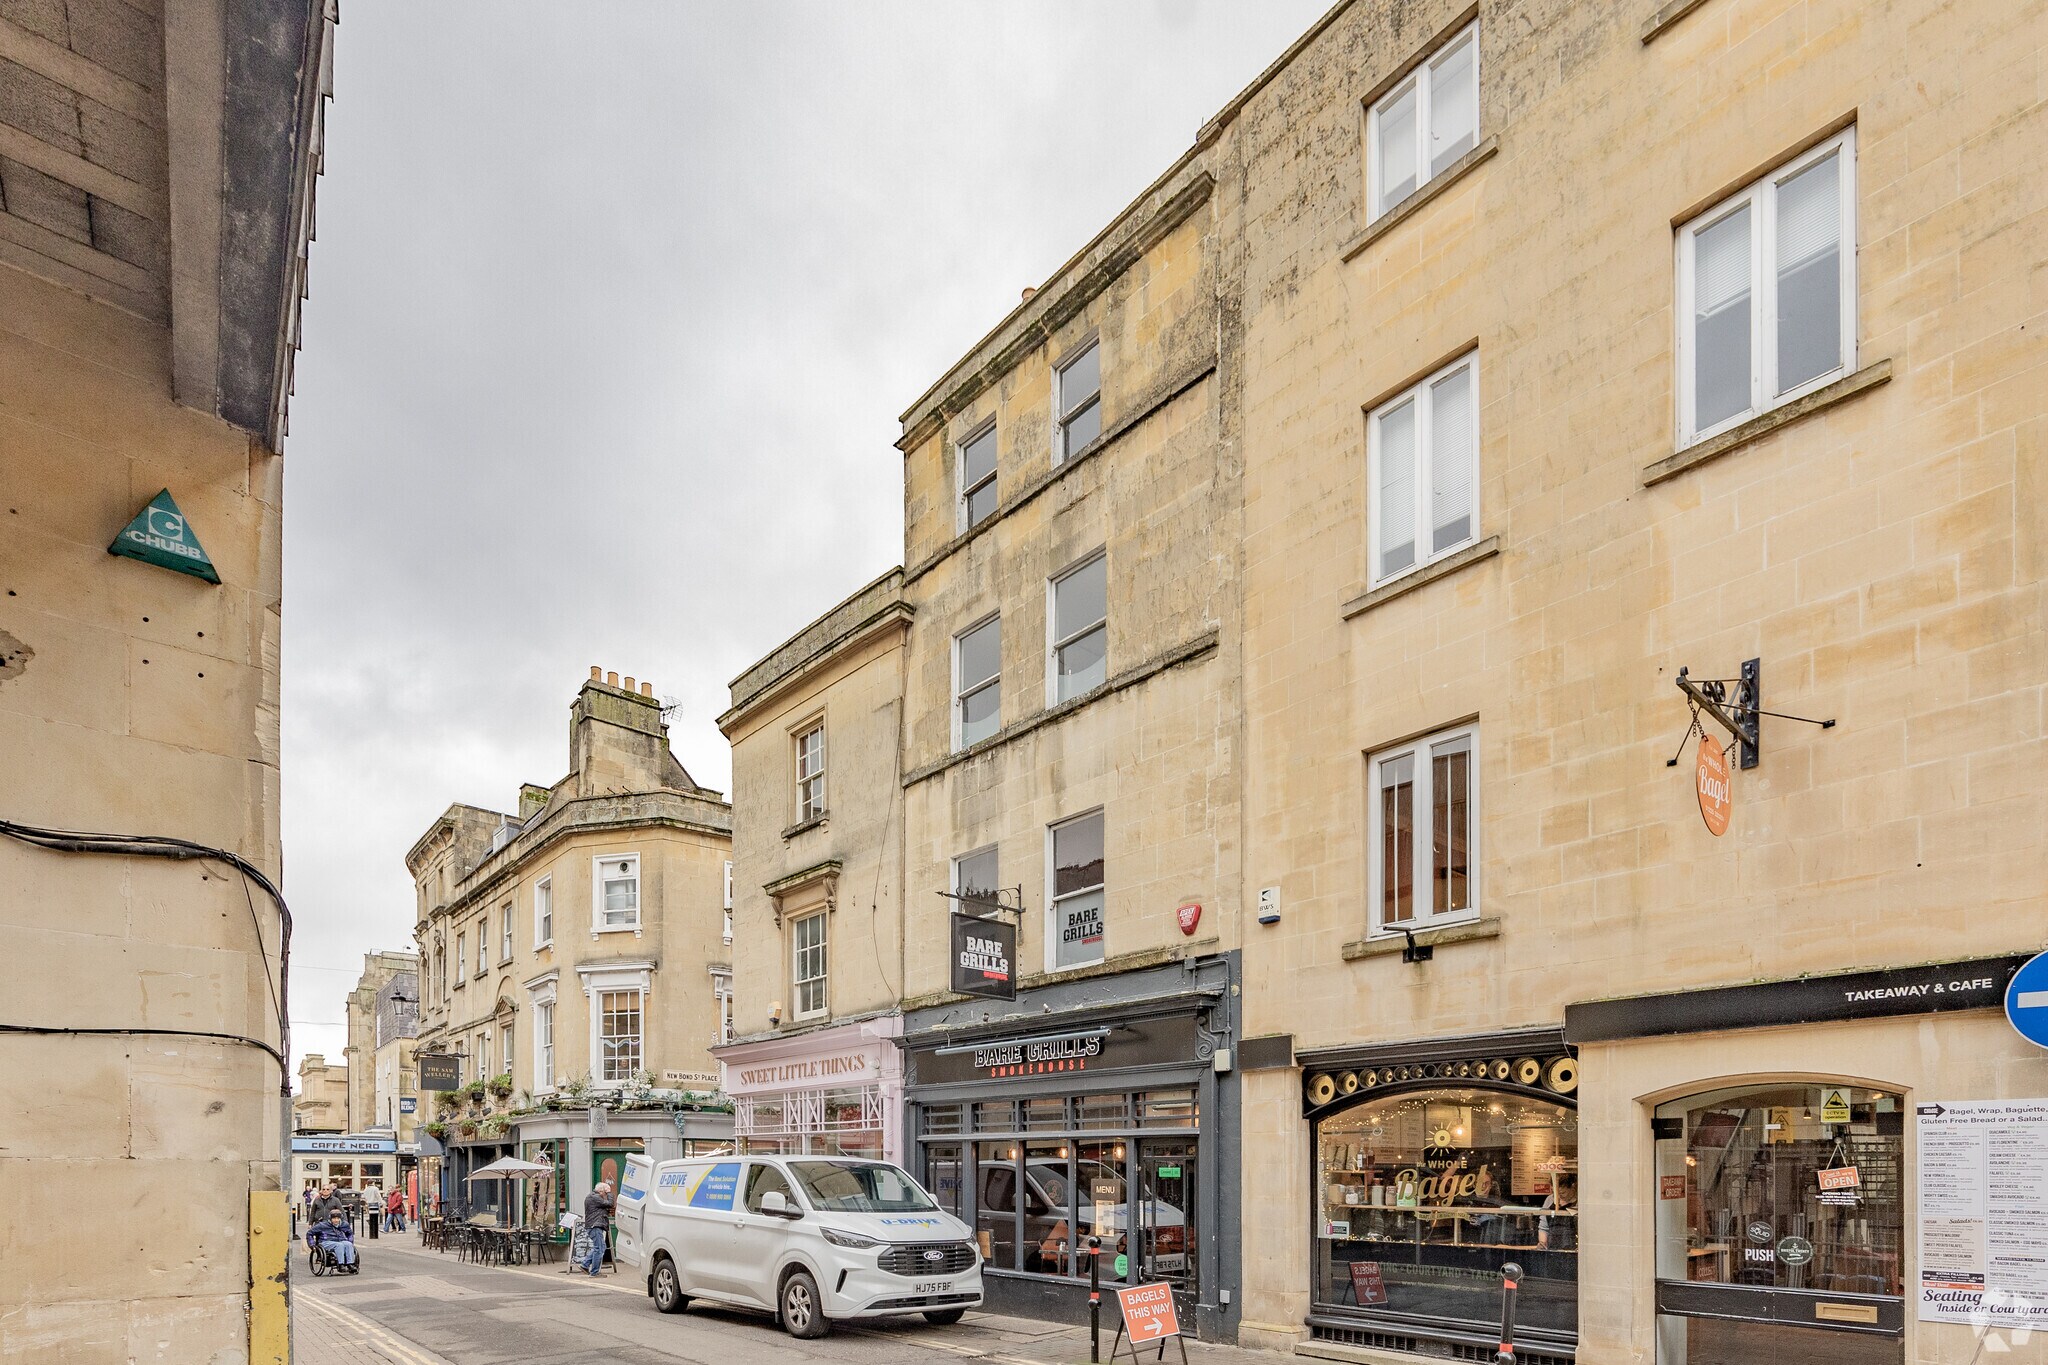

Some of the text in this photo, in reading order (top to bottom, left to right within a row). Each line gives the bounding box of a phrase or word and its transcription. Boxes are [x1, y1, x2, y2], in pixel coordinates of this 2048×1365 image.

[131, 530, 201, 559] CHUBB
[1699, 764, 1729, 809] Bagel
[1068, 907, 1098, 926] BARE
[1063, 922, 1104, 942] GRILLS
[966, 936, 1003, 955] BARE
[959, 952, 1009, 973] GRILLS
[1845, 978, 1993, 1002] TAKEAWAY & CAFE
[974, 1037, 1100, 1068] BARE GRILLS
[740, 1053, 865, 1086] SWEET LITTLE THINGS
[991, 1058, 1085, 1078] SMOKEHOUSE
[1428, 1160, 1468, 1169] WHOLE
[660, 1174, 688, 1186] U-DRIVE
[1394, 1164, 1488, 1207] Bagel
[1824, 1176, 1854, 1187] OPEN
[1750, 1226, 1770, 1237] SQUID
[1744, 1248, 1774, 1262] PUSH
[1406, 1264, 1460, 1278] COURTYARD
[916, 1282, 952, 1293] HJ75 FBF
[1127, 1289, 1166, 1305] BAGELS
[1923, 1289, 1982, 1305] Seating
[1128, 1302, 1170, 1320] THIS WAY
[1936, 1303, 1972, 1312] Inside
